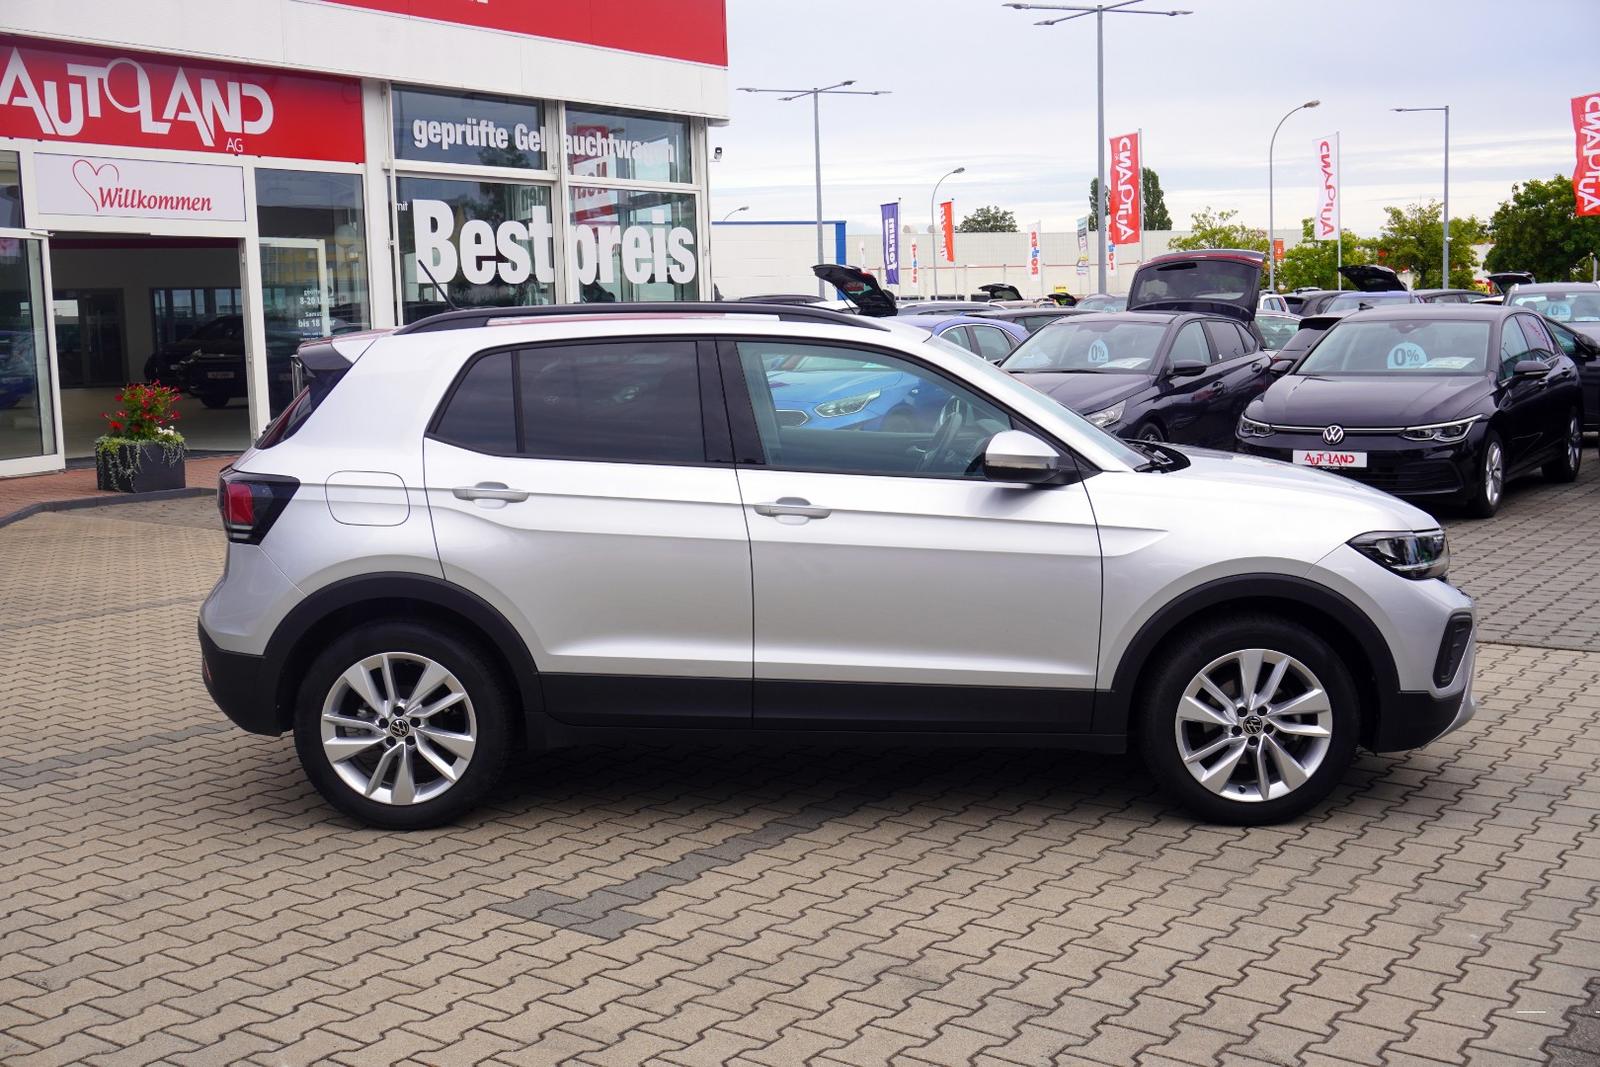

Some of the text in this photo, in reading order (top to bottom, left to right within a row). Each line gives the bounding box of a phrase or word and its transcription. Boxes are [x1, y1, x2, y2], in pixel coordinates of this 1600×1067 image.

[225, 137, 244, 153] AG
[413, 117, 508, 150] geprüfte
[97, 186, 213, 212] Willkommen
[1393, 347, 1420, 367] 0%
